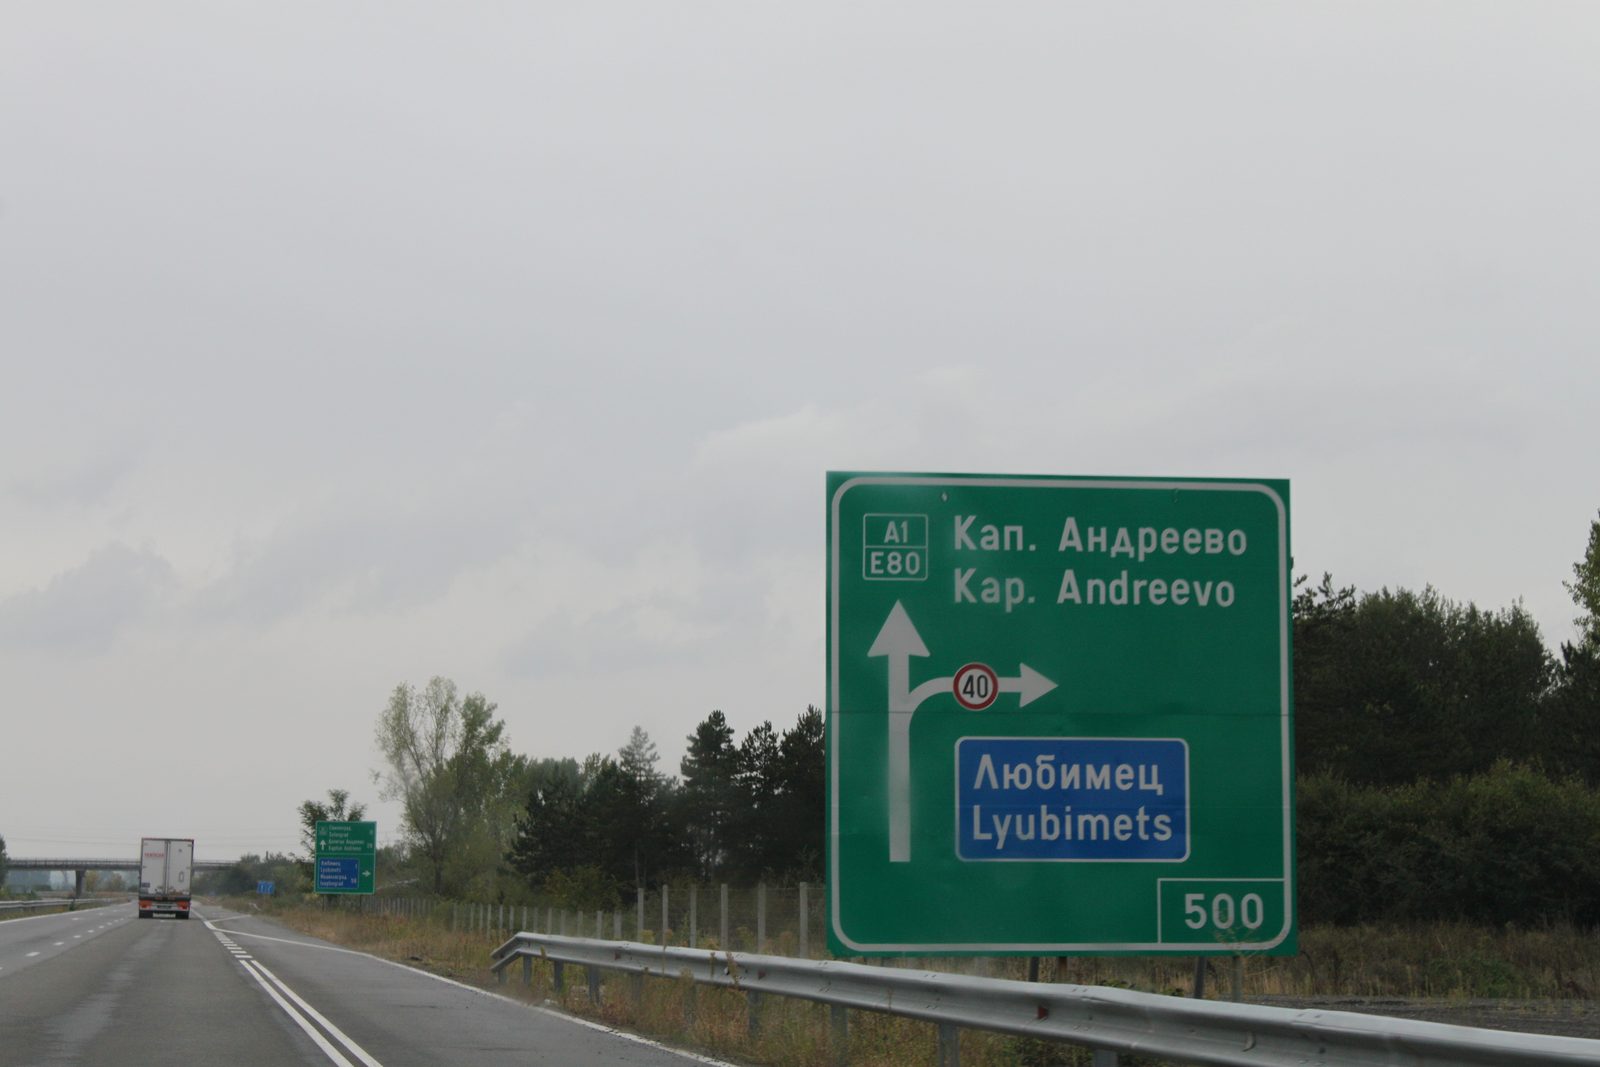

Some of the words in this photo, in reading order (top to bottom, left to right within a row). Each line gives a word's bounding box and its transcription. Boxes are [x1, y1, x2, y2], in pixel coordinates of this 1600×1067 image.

[884, 521, 908, 543] A1
[954, 515, 1036, 551] Кап.
[1058, 517, 1247, 562] Андреево
[870, 551, 920, 575] E80
[954, 568, 1035, 612] Kap.
[1057, 569, 1235, 607] Andreevo
[962, 674, 989, 698] 40
[974, 753, 1163, 796] Любимец
[973, 804, 1172, 849] Lyubimets
[1185, 893, 1264, 929] 500
